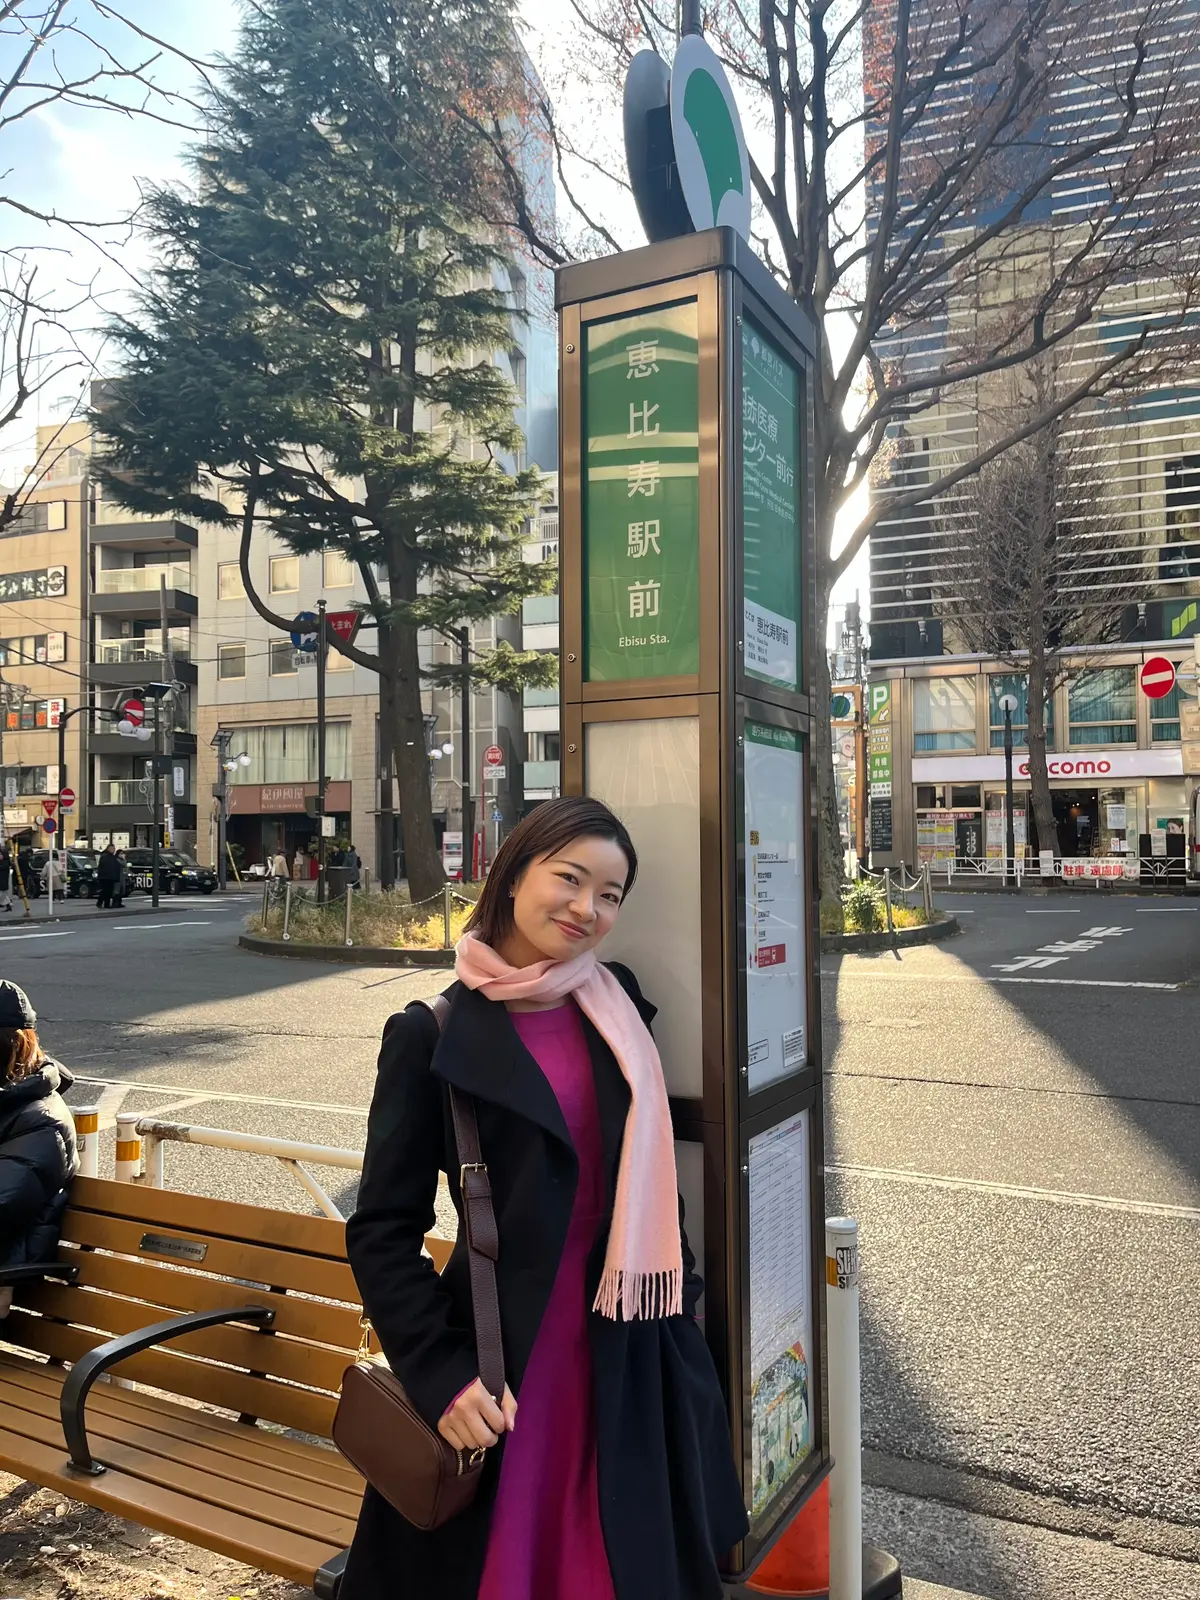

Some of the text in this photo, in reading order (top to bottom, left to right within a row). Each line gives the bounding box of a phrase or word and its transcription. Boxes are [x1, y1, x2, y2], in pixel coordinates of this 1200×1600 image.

[626, 339, 661, 619] 恵比寿駅前
[619, 633, 670, 648] Ebisu Sta.
[757, 616, 789, 646] 恵比寿駅前
[873, 685, 888, 711] P
[1018, 757, 1111, 776] dcomo
[262, 787, 304, 801] 紀伊國屋
